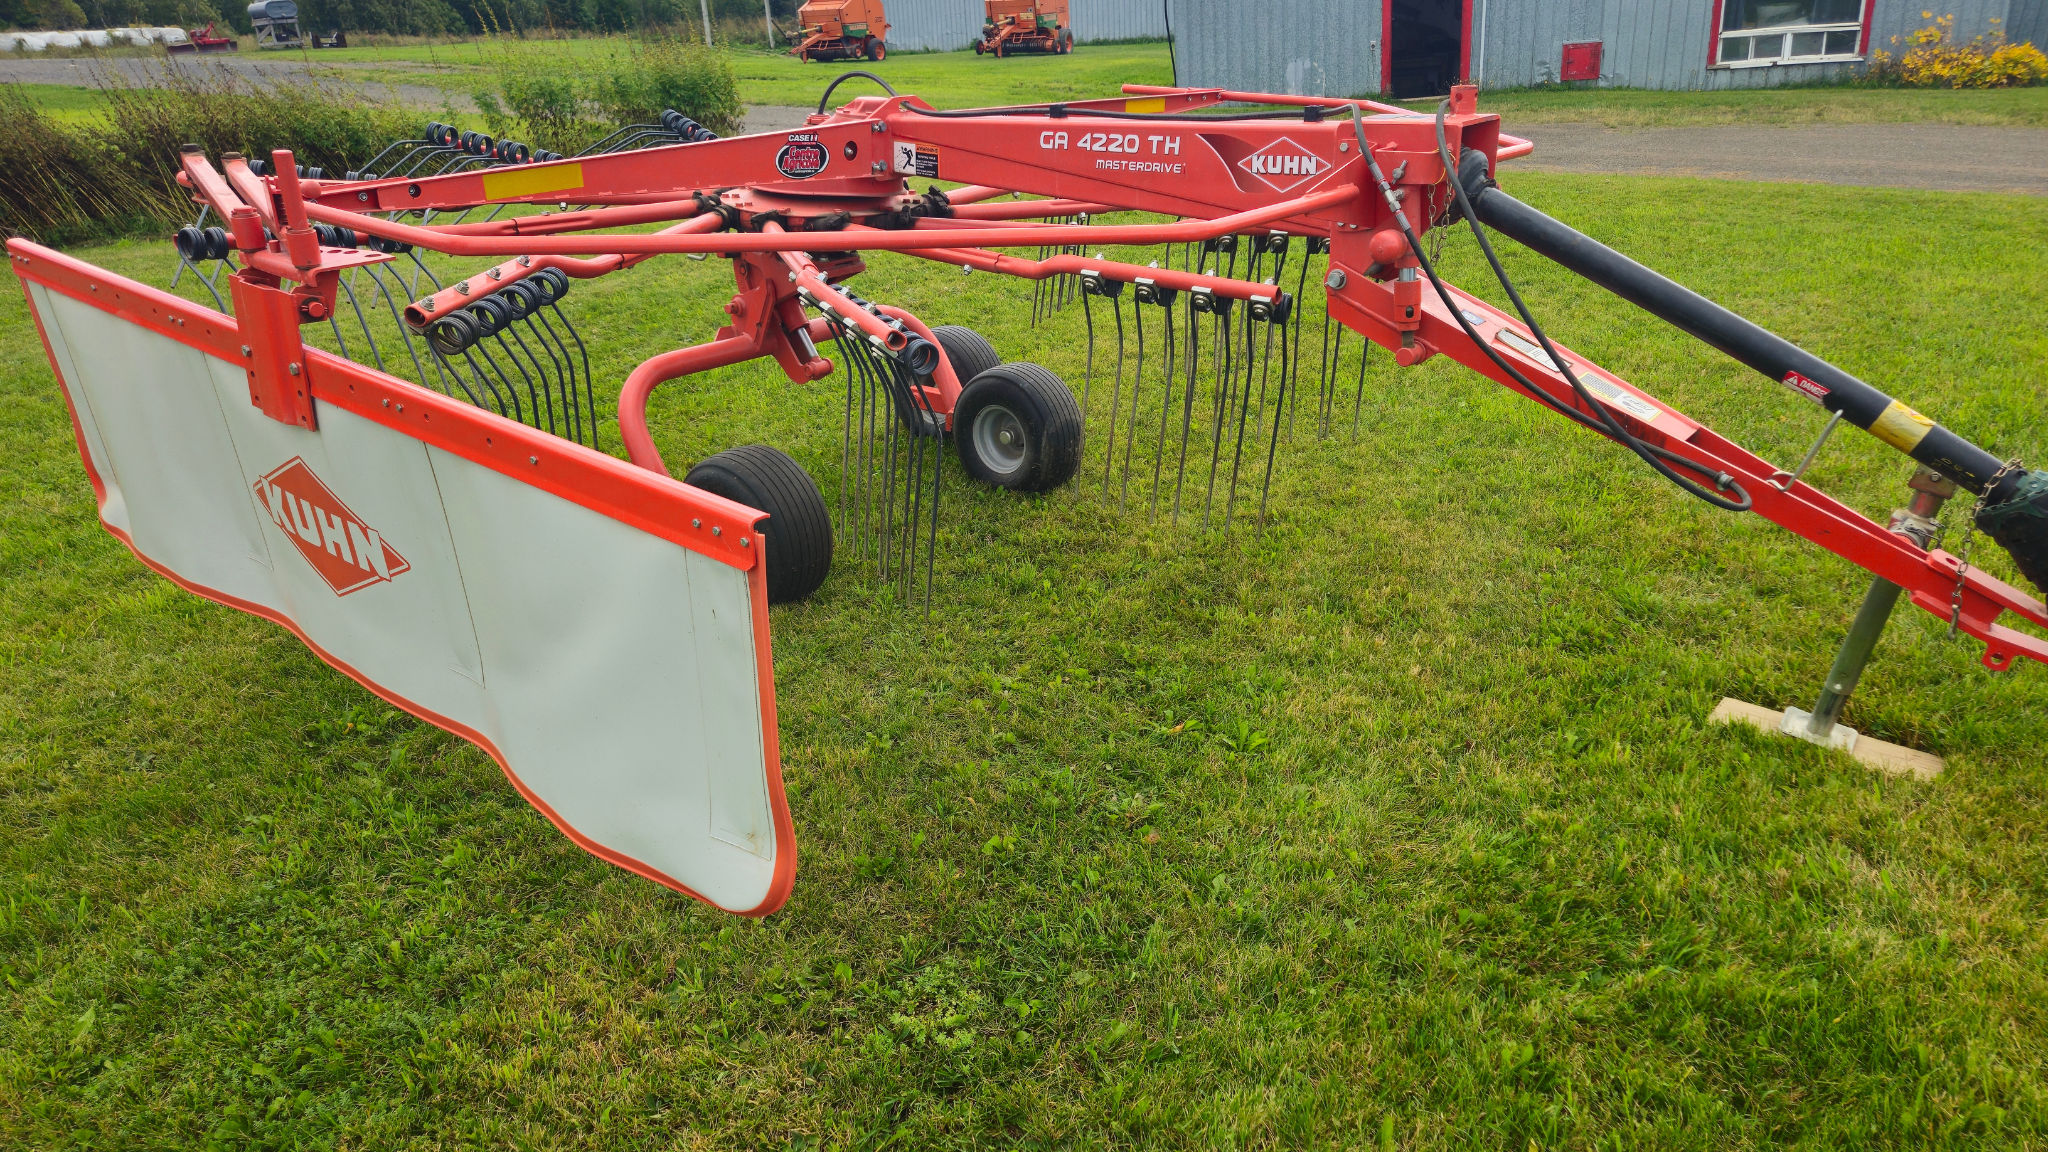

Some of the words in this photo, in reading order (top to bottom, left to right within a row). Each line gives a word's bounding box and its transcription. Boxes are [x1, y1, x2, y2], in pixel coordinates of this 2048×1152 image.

[788, 134, 810, 142] CASE
[1039, 131, 1069, 150] GA
[1077, 132, 1140, 154] 4220
[1147, 135, 1181, 156] TH
[1095, 159, 1182, 174] MASTERDRIVE
[1251, 155, 1317, 175] KUHN
[260, 476, 391, 581] KUHN
